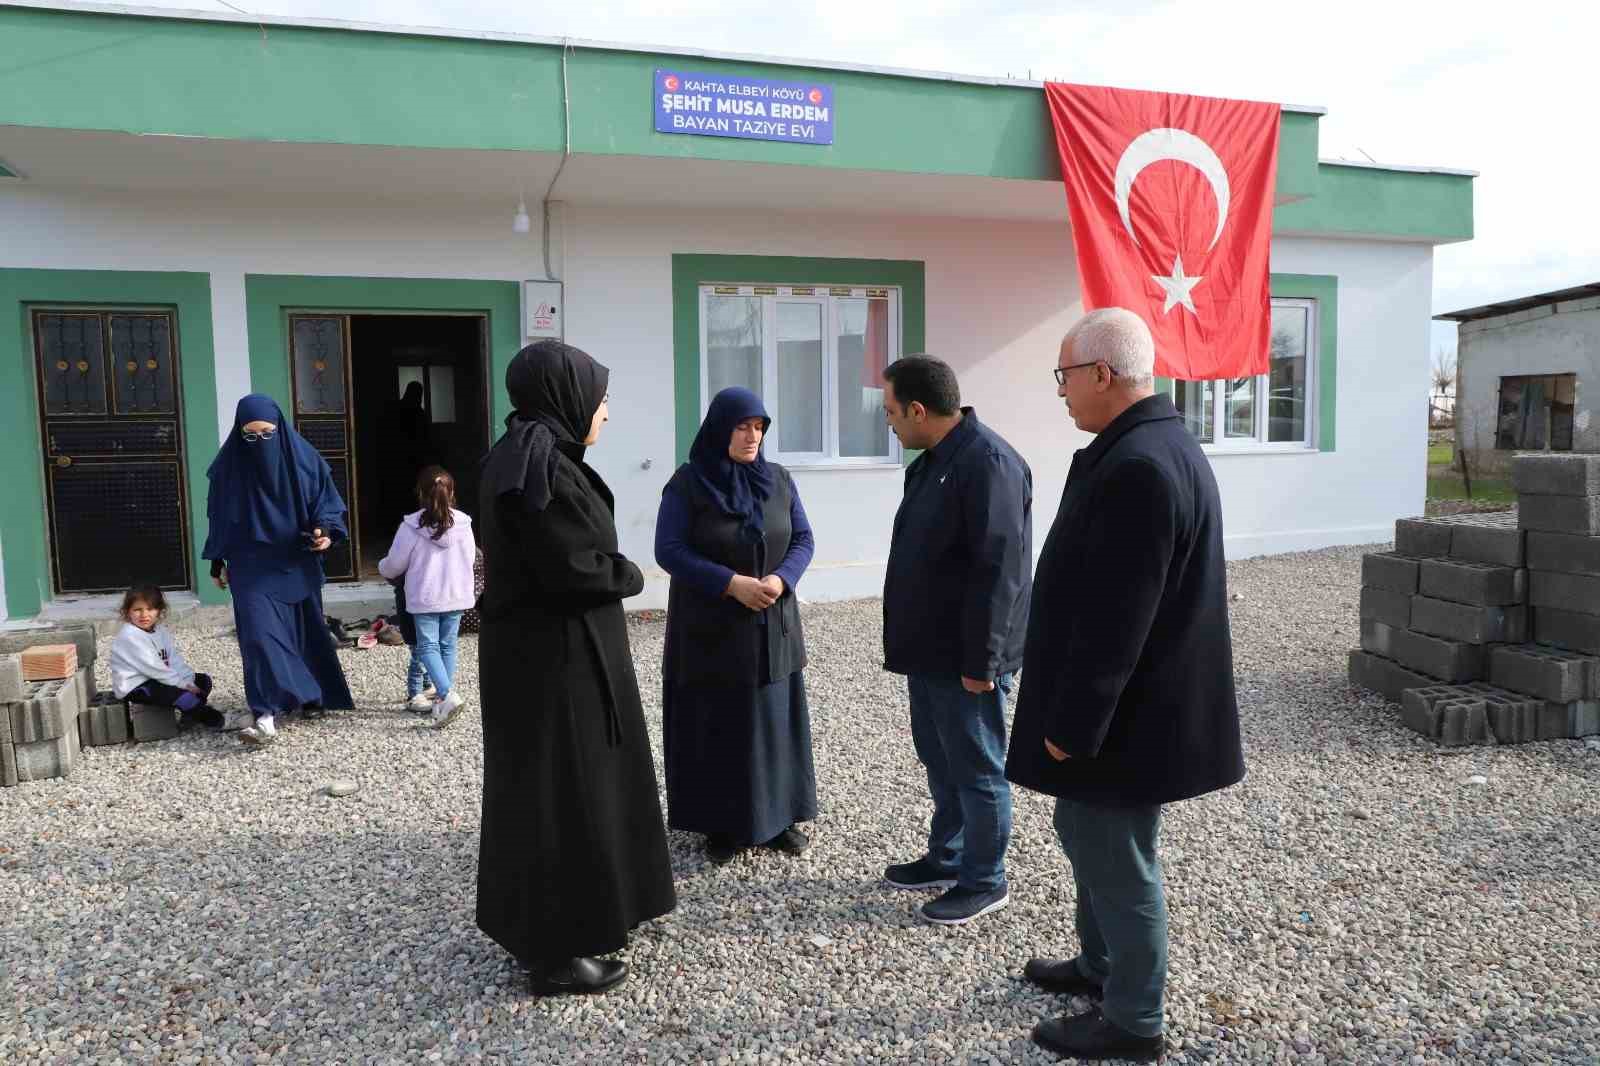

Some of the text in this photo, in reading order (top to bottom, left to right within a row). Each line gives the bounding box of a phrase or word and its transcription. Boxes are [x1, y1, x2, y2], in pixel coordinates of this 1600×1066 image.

[684, 80, 725, 94] KAHTA
[772, 87, 804, 101] KÖYÜ
[717, 98, 766, 117] MUSA
[771, 103, 828, 122] ERDEM
[673, 115, 729, 132] BAYAN
